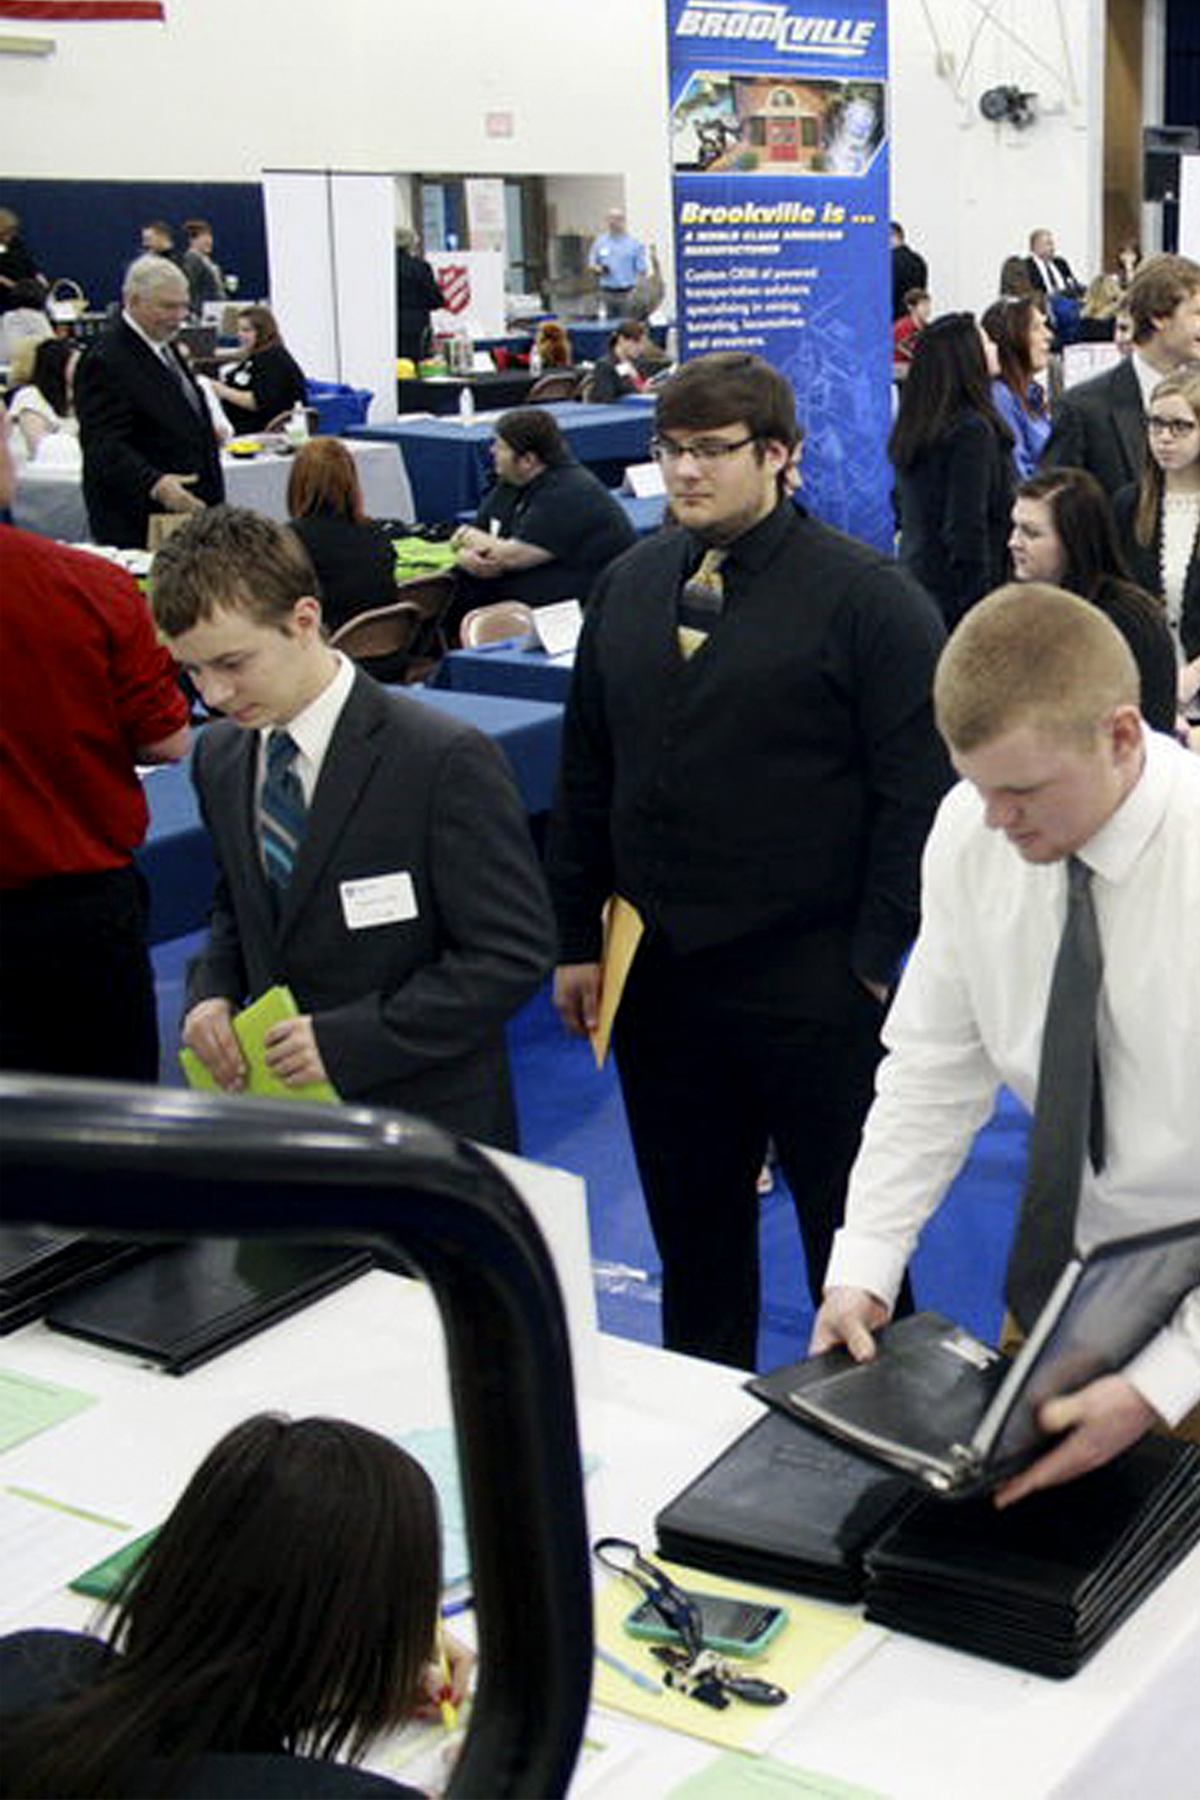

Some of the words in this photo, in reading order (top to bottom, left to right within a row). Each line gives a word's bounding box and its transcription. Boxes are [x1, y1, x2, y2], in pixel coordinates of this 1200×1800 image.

[676, 4, 876, 53] BROOKVILLE
[681, 201, 816, 224] Brookville
[822, 202, 846, 224] is
